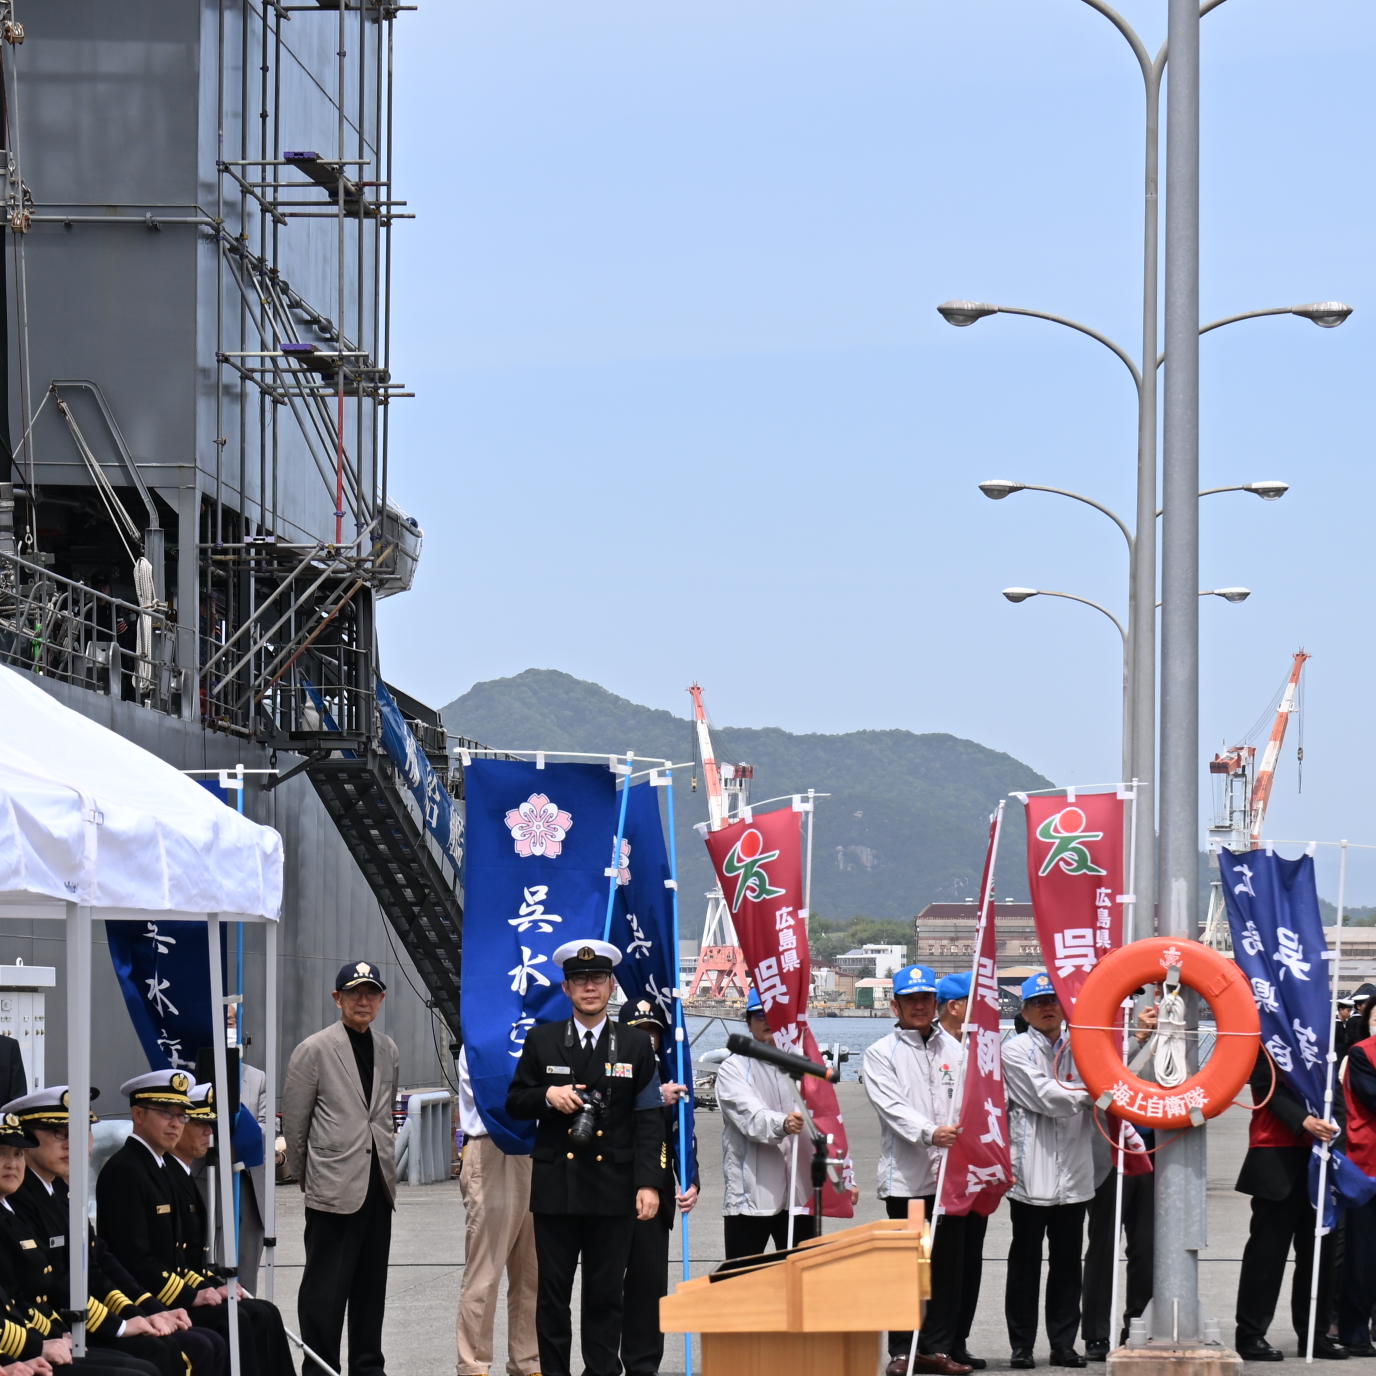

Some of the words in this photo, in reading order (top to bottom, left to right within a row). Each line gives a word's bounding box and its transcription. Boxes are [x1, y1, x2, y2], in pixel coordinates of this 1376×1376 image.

[776, 906, 800, 973] 広島県
[1096, 887, 1112, 949] 広島県
[1110, 1081, 1210, 1119] 海上自衛隊
